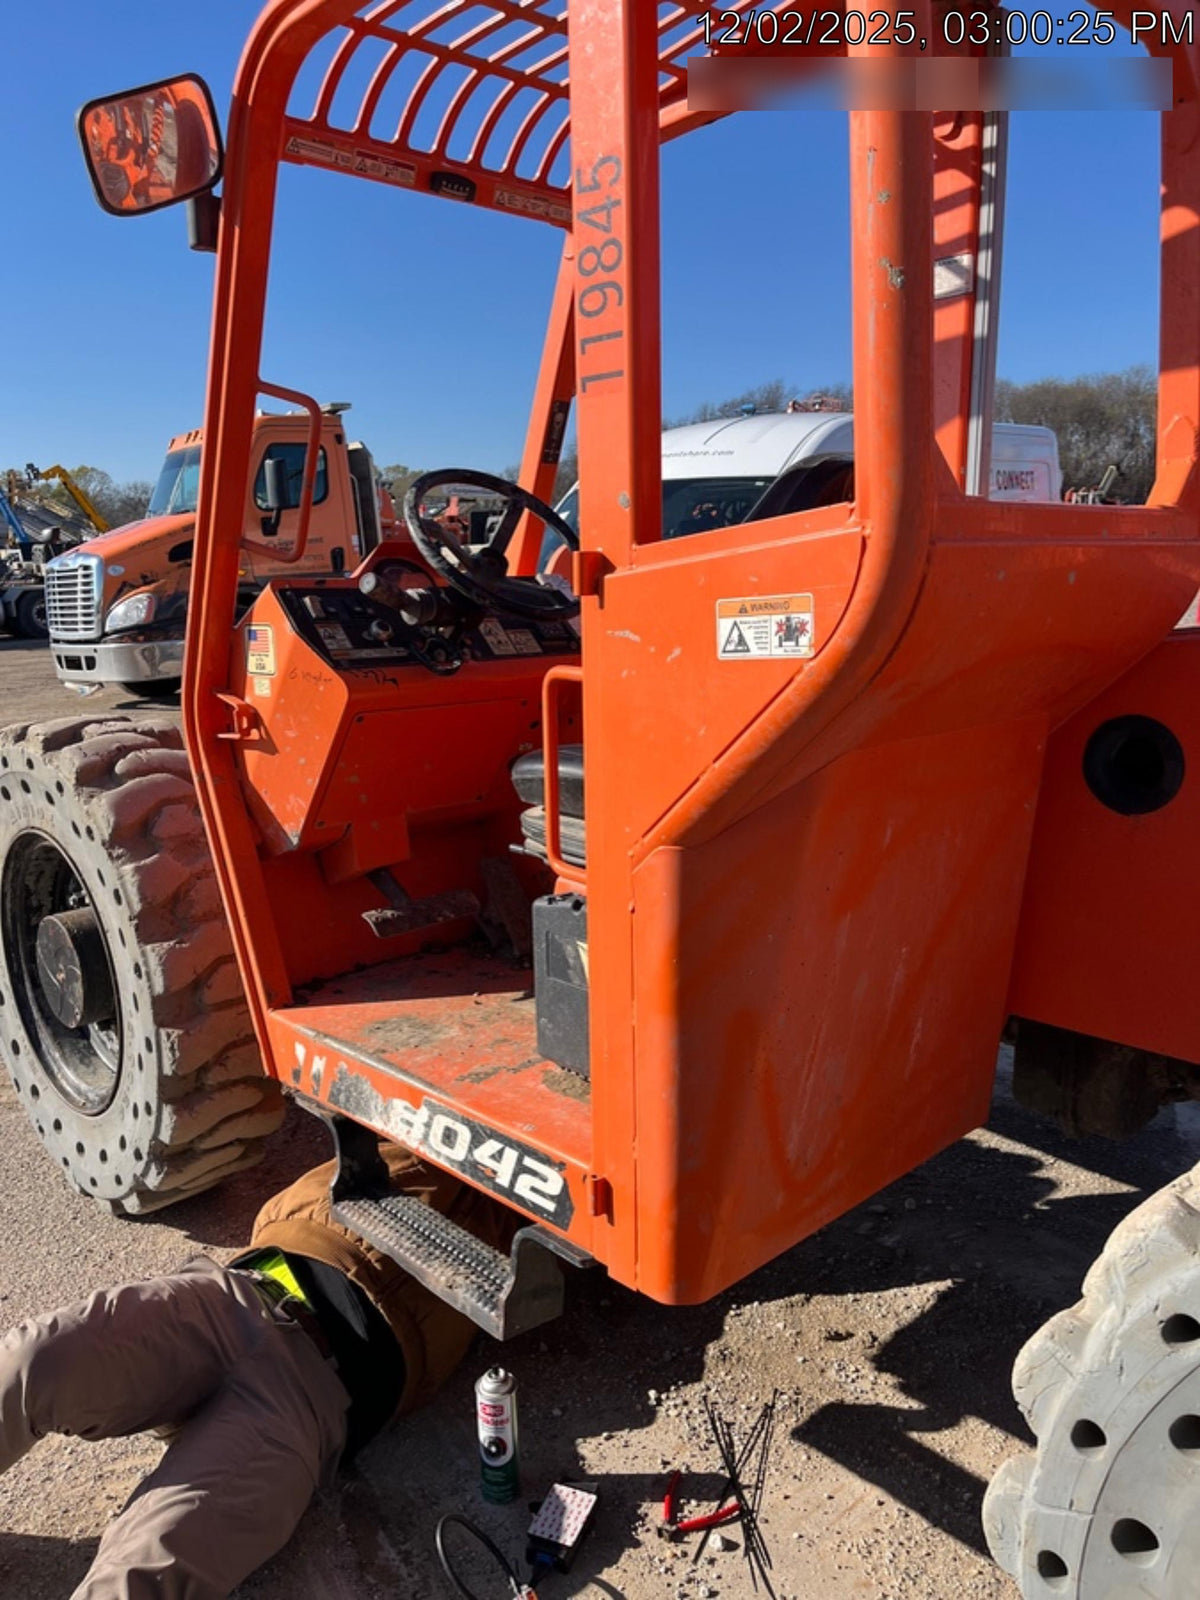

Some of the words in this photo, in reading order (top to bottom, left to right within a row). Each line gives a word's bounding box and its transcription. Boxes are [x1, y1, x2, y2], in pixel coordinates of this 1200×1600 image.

[576, 154, 624, 393] 119845
[996, 469, 1034, 490] CONNECT
[750, 601, 791, 612] WARNING
[388, 1098, 565, 1212] 8042
